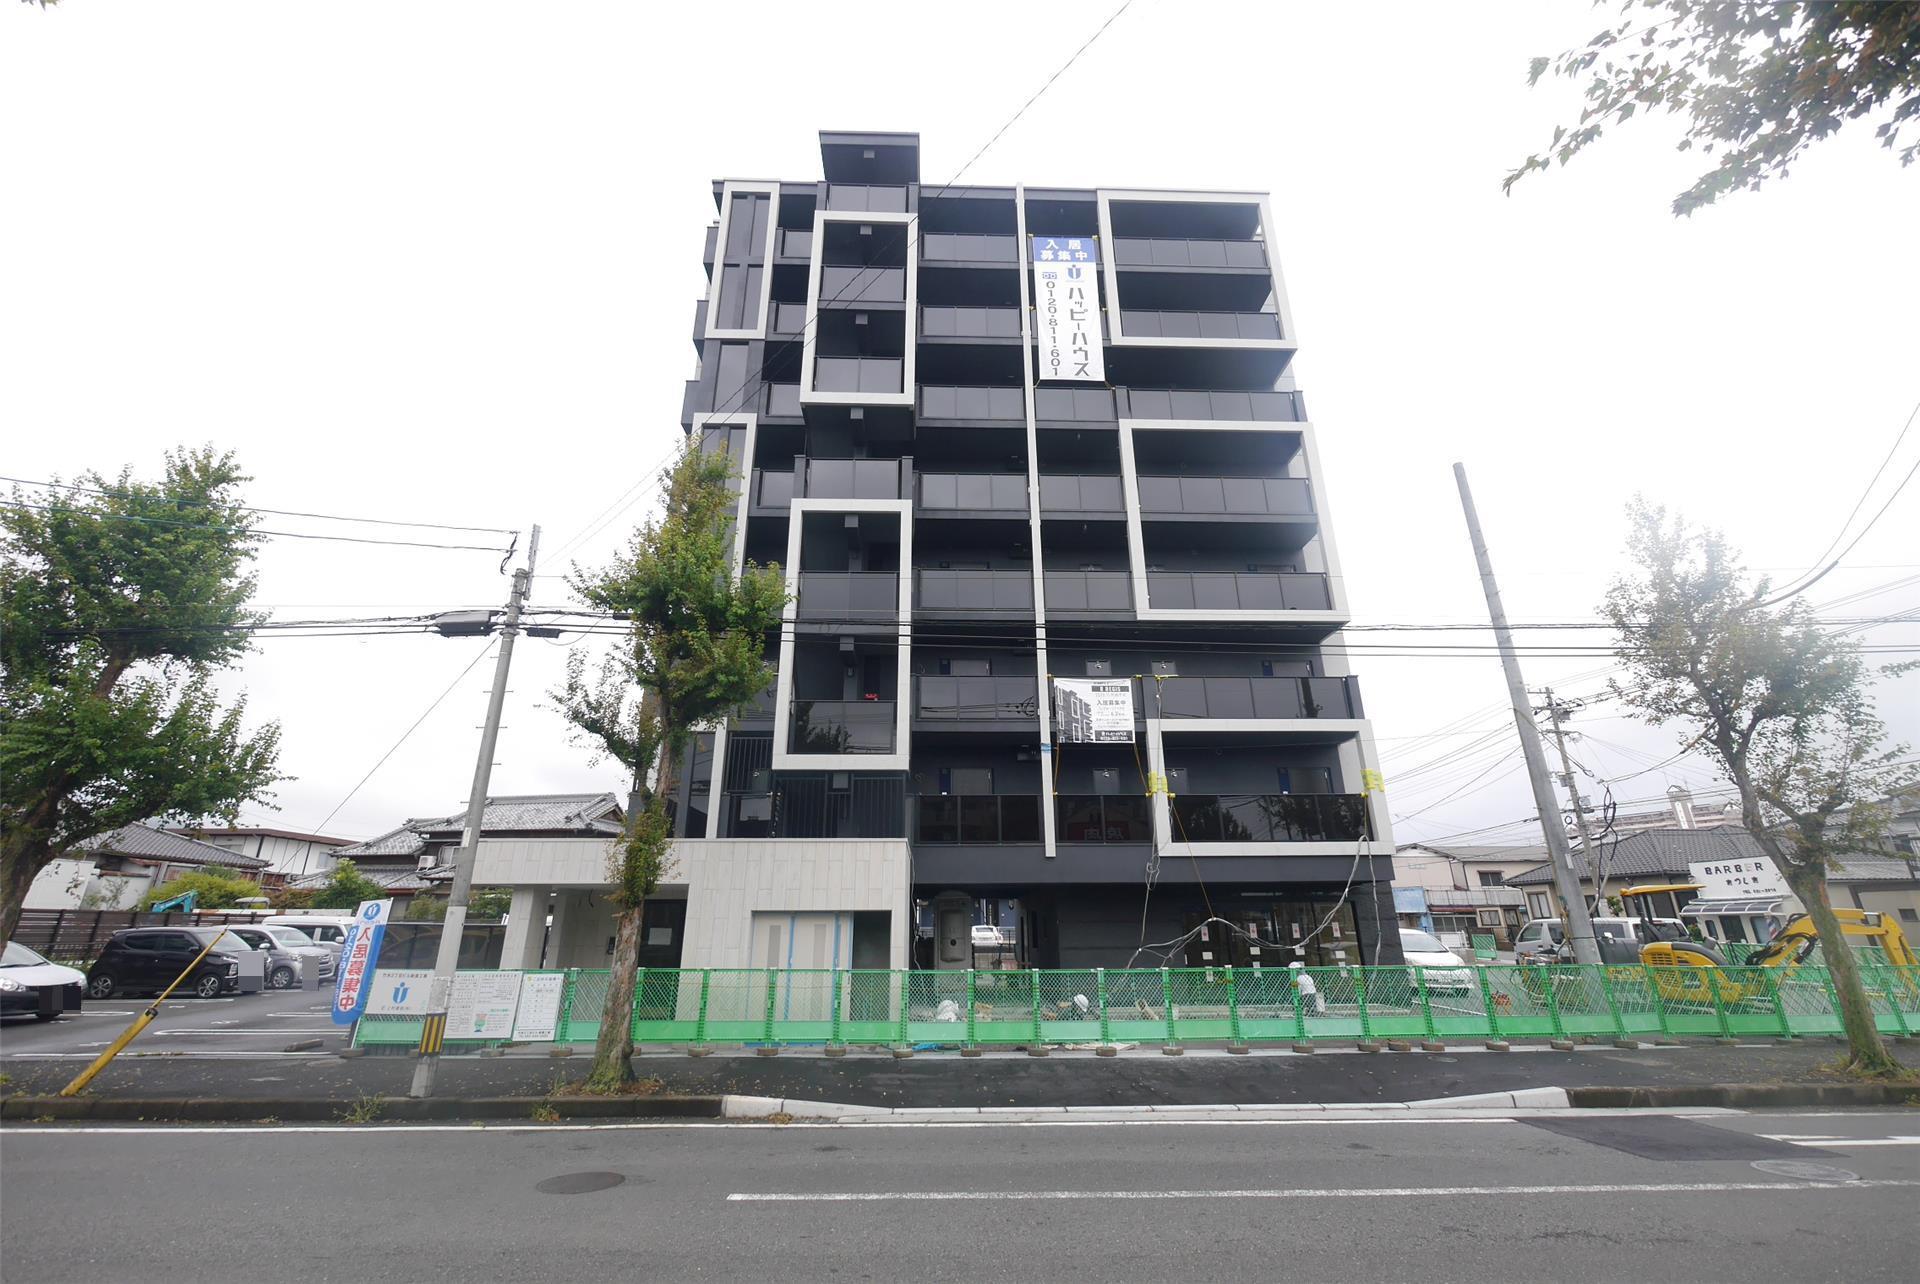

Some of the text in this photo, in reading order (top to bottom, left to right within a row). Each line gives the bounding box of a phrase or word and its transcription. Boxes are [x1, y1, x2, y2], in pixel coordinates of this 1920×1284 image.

[1046, 239, 1081, 250] 入居
[1040, 250, 1088, 261] 募集中
[1068, 287, 1090, 377] ハッピーハウス
[1704, 862, 1763, 875] BARBER
